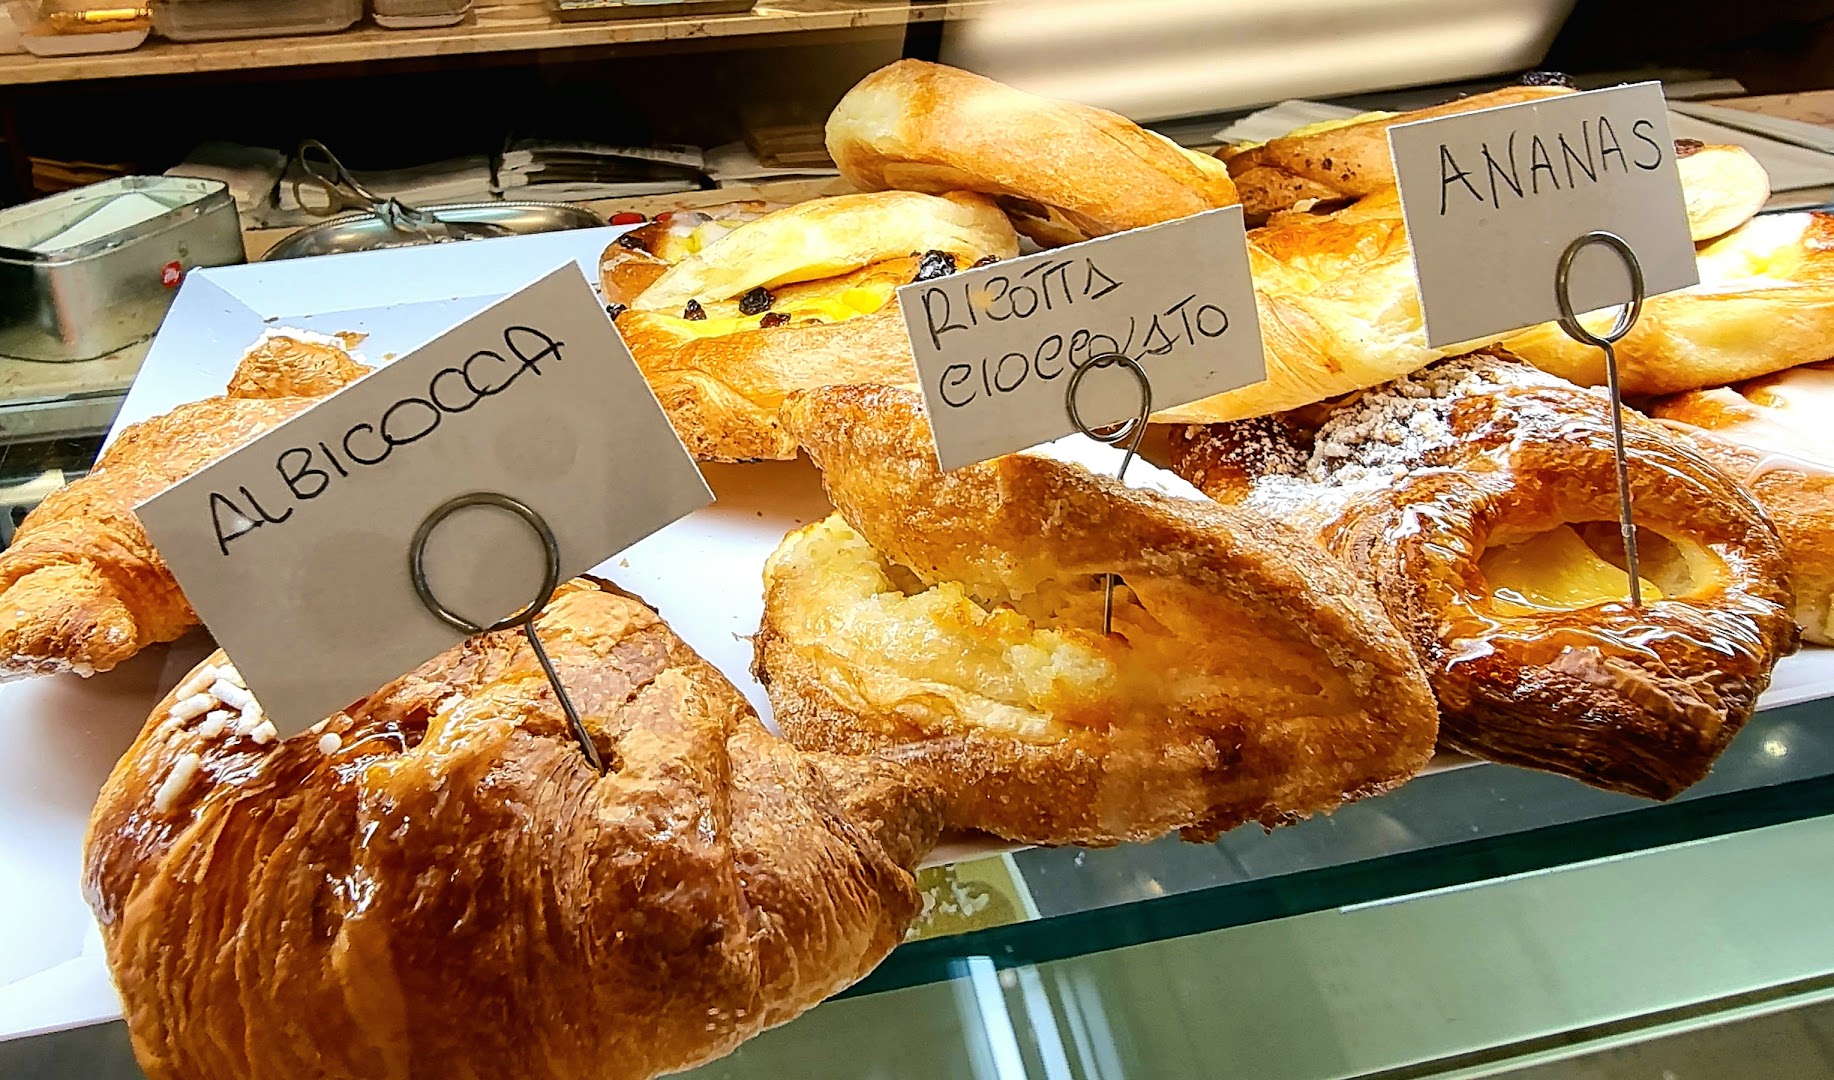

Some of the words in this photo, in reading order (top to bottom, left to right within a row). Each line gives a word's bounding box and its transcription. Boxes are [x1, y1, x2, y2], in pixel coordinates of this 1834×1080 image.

[1439, 115, 1663, 216] ANANAS
[921, 258, 1123, 351] RICOTTA
[210, 326, 565, 556] ALBICOCCA
